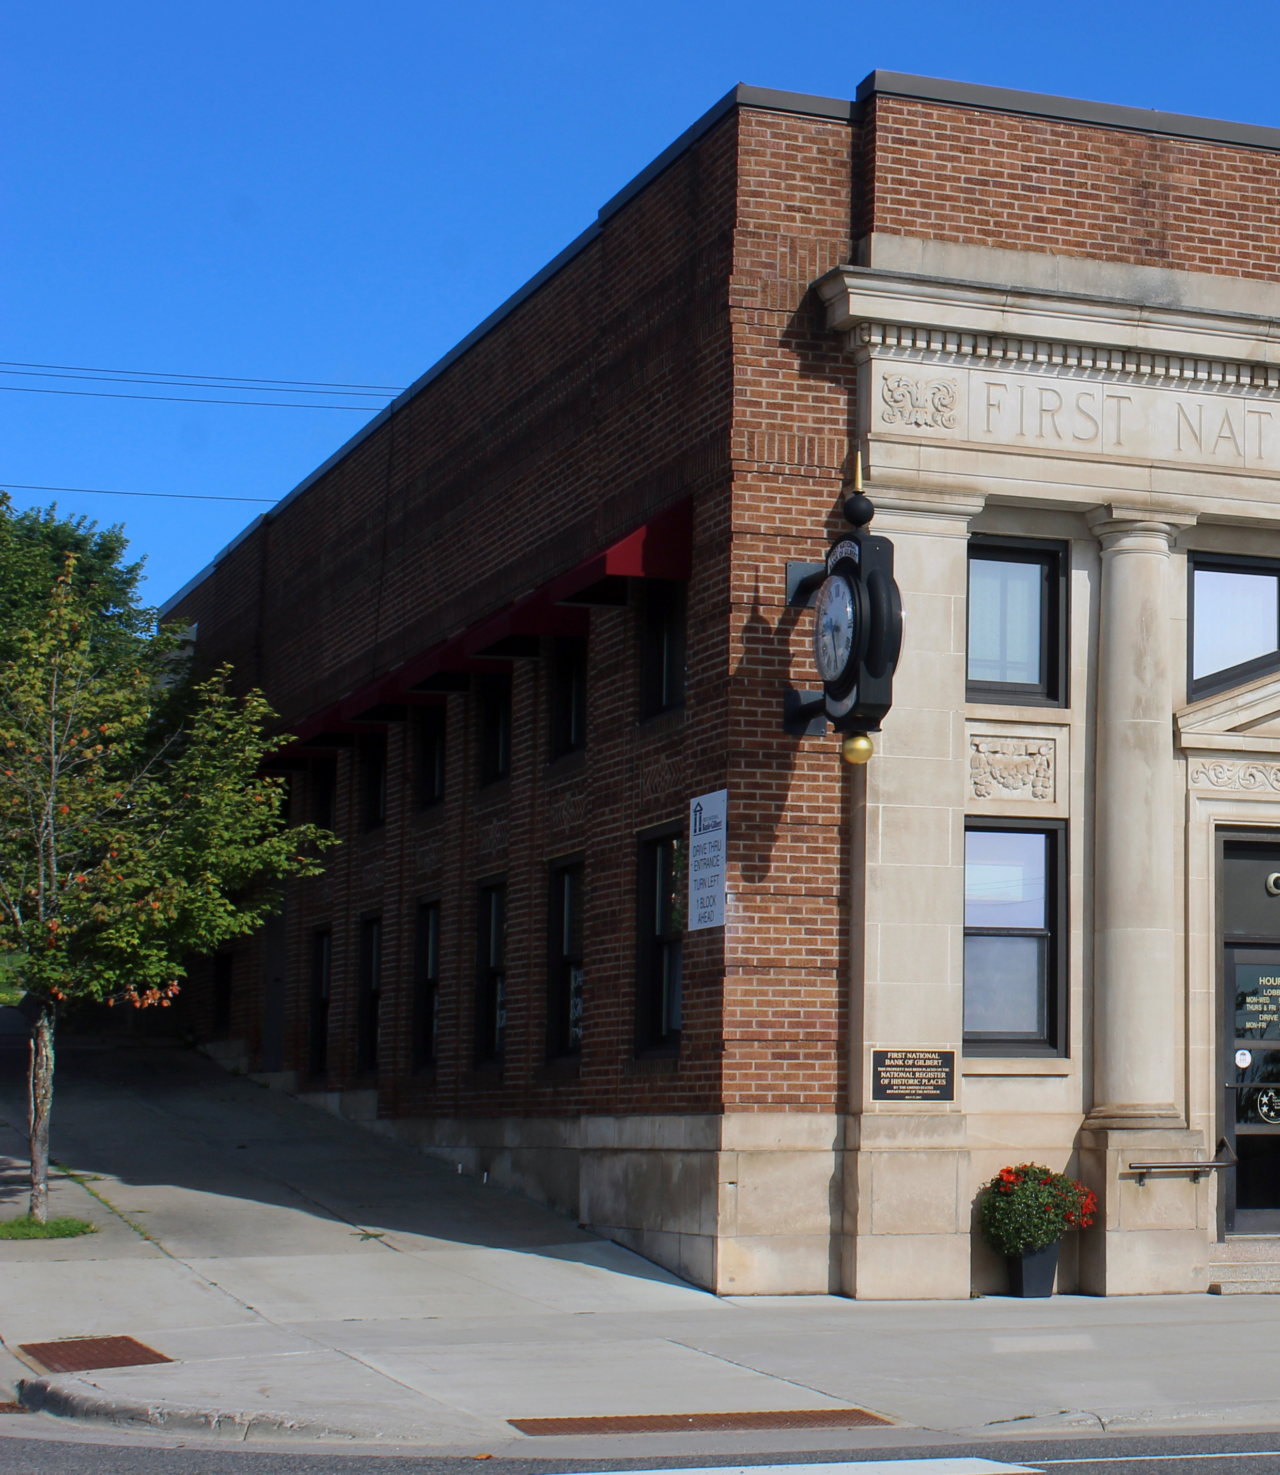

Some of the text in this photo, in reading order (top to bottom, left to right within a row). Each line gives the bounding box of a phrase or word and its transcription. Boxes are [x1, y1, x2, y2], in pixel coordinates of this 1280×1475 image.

[984, 382, 1133, 445] FIRST
[693, 839, 721, 857] DRIVE THRU
[694, 855, 720, 872] ENTRANCE
[694, 874, 720, 891] TURN LEFT
[700, 895, 717, 909] BLOCK
[697, 910, 714, 924] AHEAD
